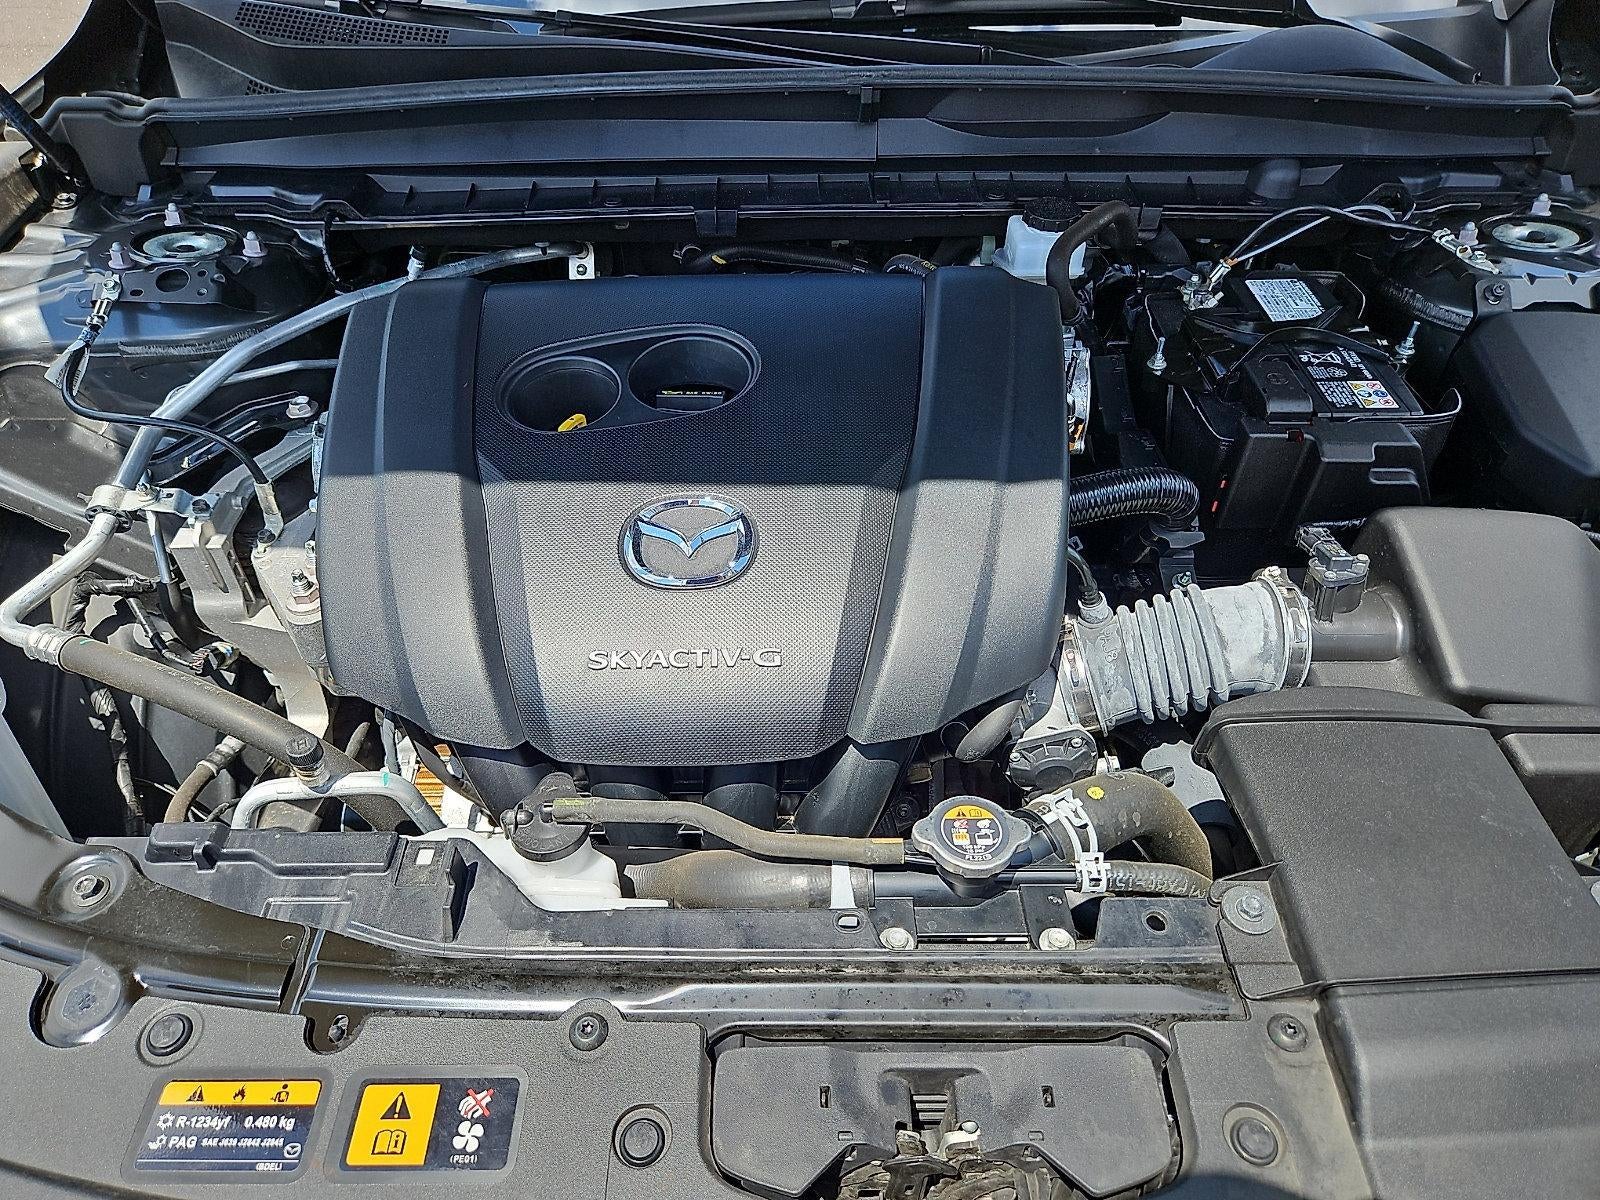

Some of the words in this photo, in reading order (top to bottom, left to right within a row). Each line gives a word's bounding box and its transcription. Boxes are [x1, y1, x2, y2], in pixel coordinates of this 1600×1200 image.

[587, 648, 783, 670] SKYACTIV-G
[175, 1115, 232, 1130] R-1234yf
[244, 1116, 277, 1129] 0.480
[278, 1115, 296, 1131] kg
[168, 1136, 198, 1149] PAG
[201, 1138, 219, 1147] SAE
